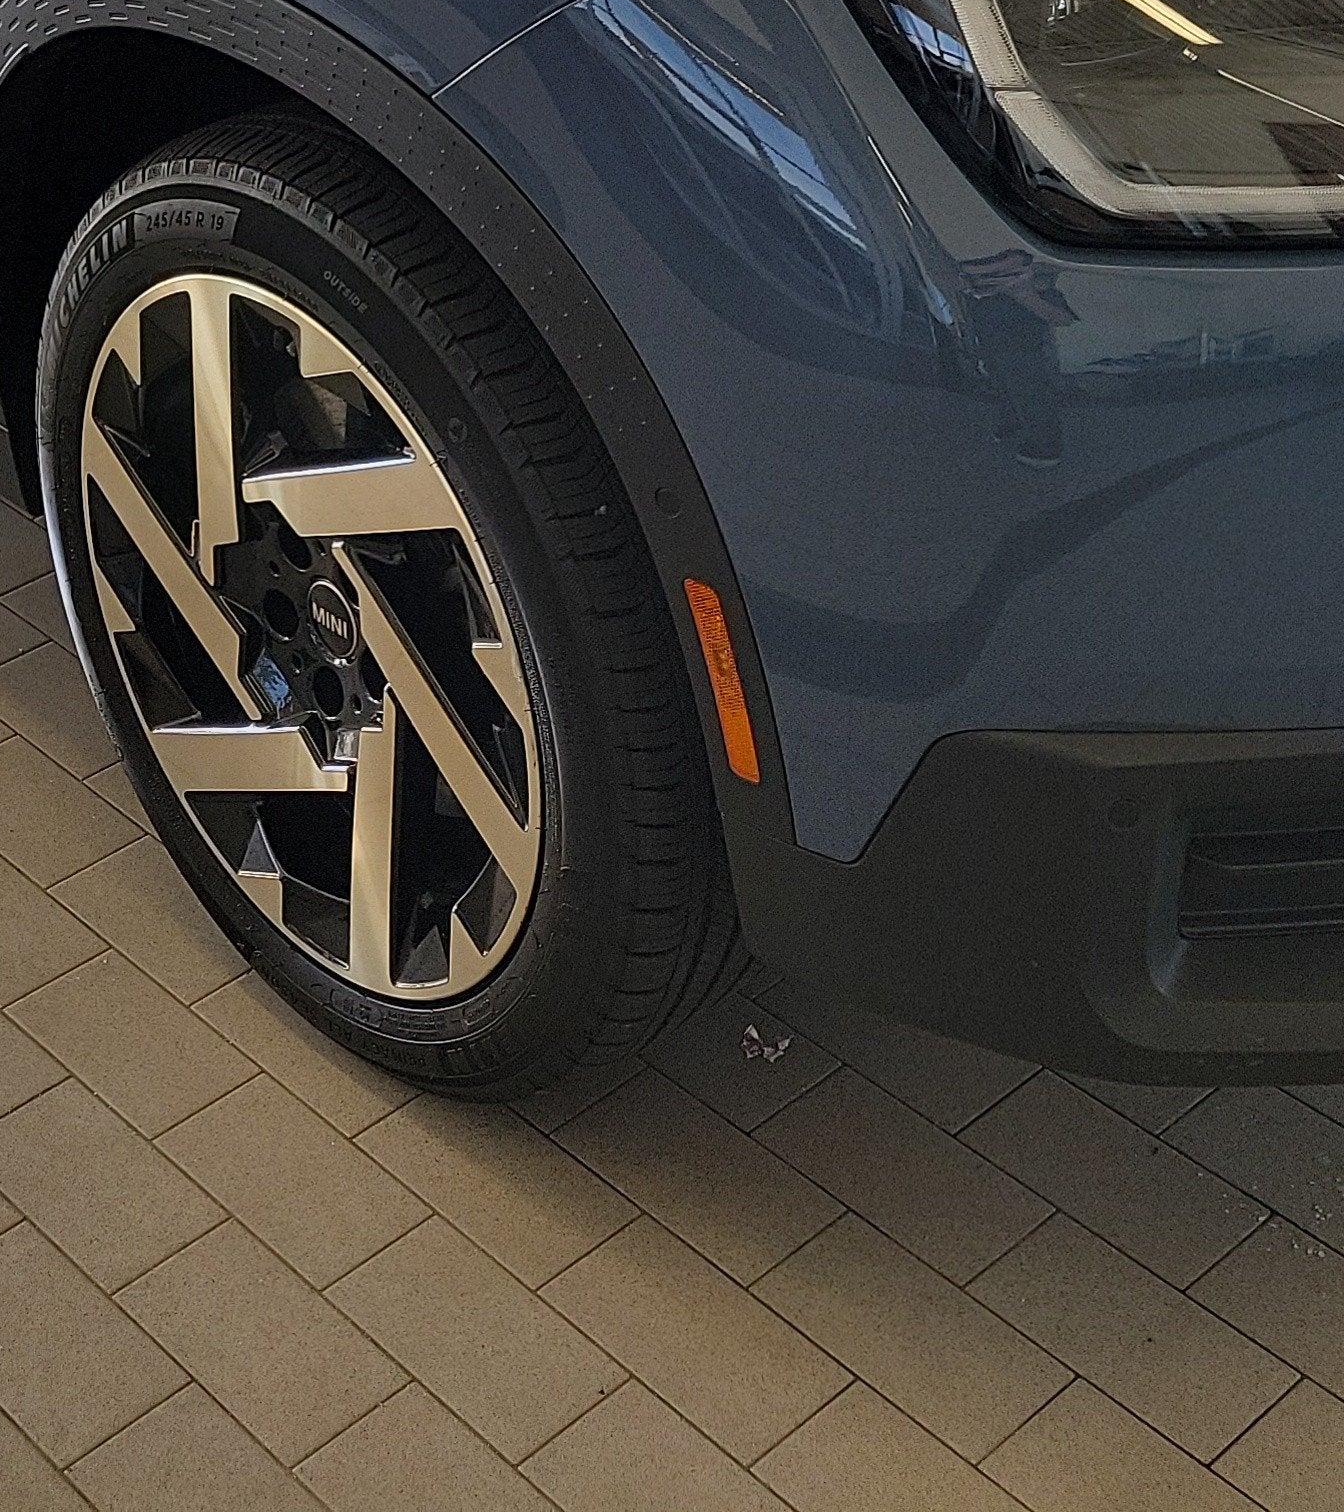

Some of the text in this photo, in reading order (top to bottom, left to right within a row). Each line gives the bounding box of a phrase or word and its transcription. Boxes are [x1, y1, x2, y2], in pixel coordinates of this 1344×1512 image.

[146, 210, 224, 232] 245/45 R 19
[323, 270, 367, 314] OUTSIDE
[312, 601, 348, 640] MINI
